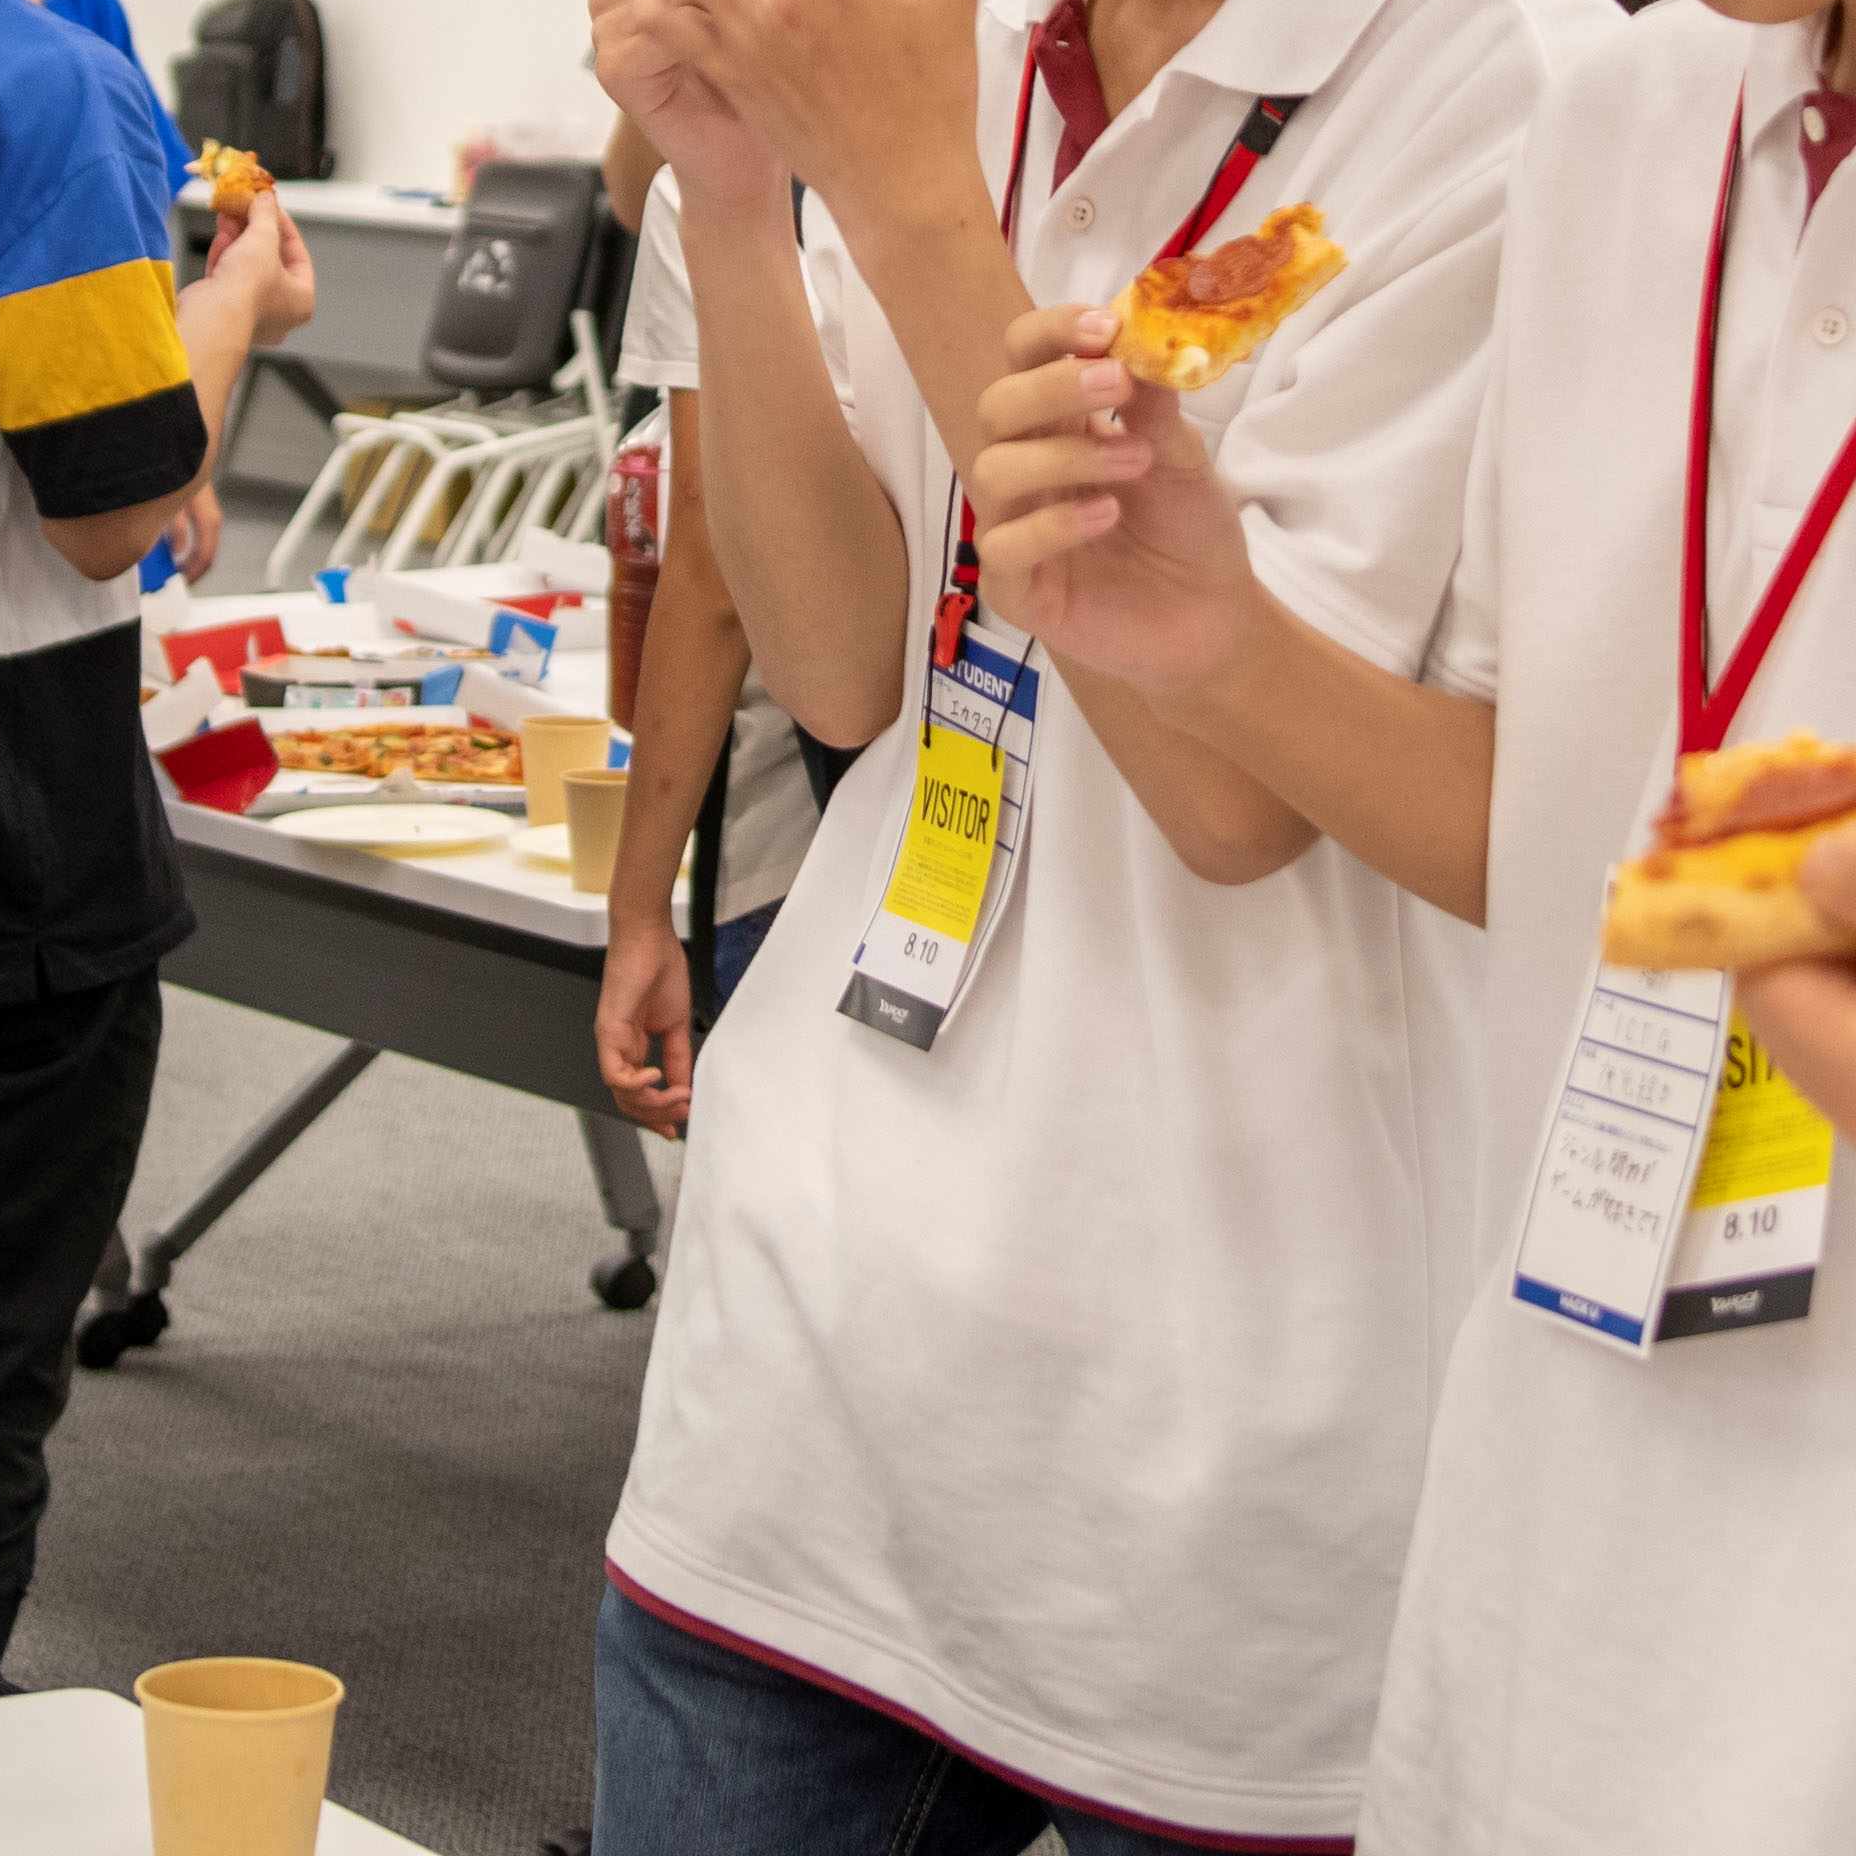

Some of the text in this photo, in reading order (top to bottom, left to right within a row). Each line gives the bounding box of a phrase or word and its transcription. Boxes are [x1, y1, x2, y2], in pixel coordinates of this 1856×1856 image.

[921, 775, 991, 845] VISITOR
[904, 932, 939, 965] 8.10
[1724, 1204, 1778, 1240] 8.10
